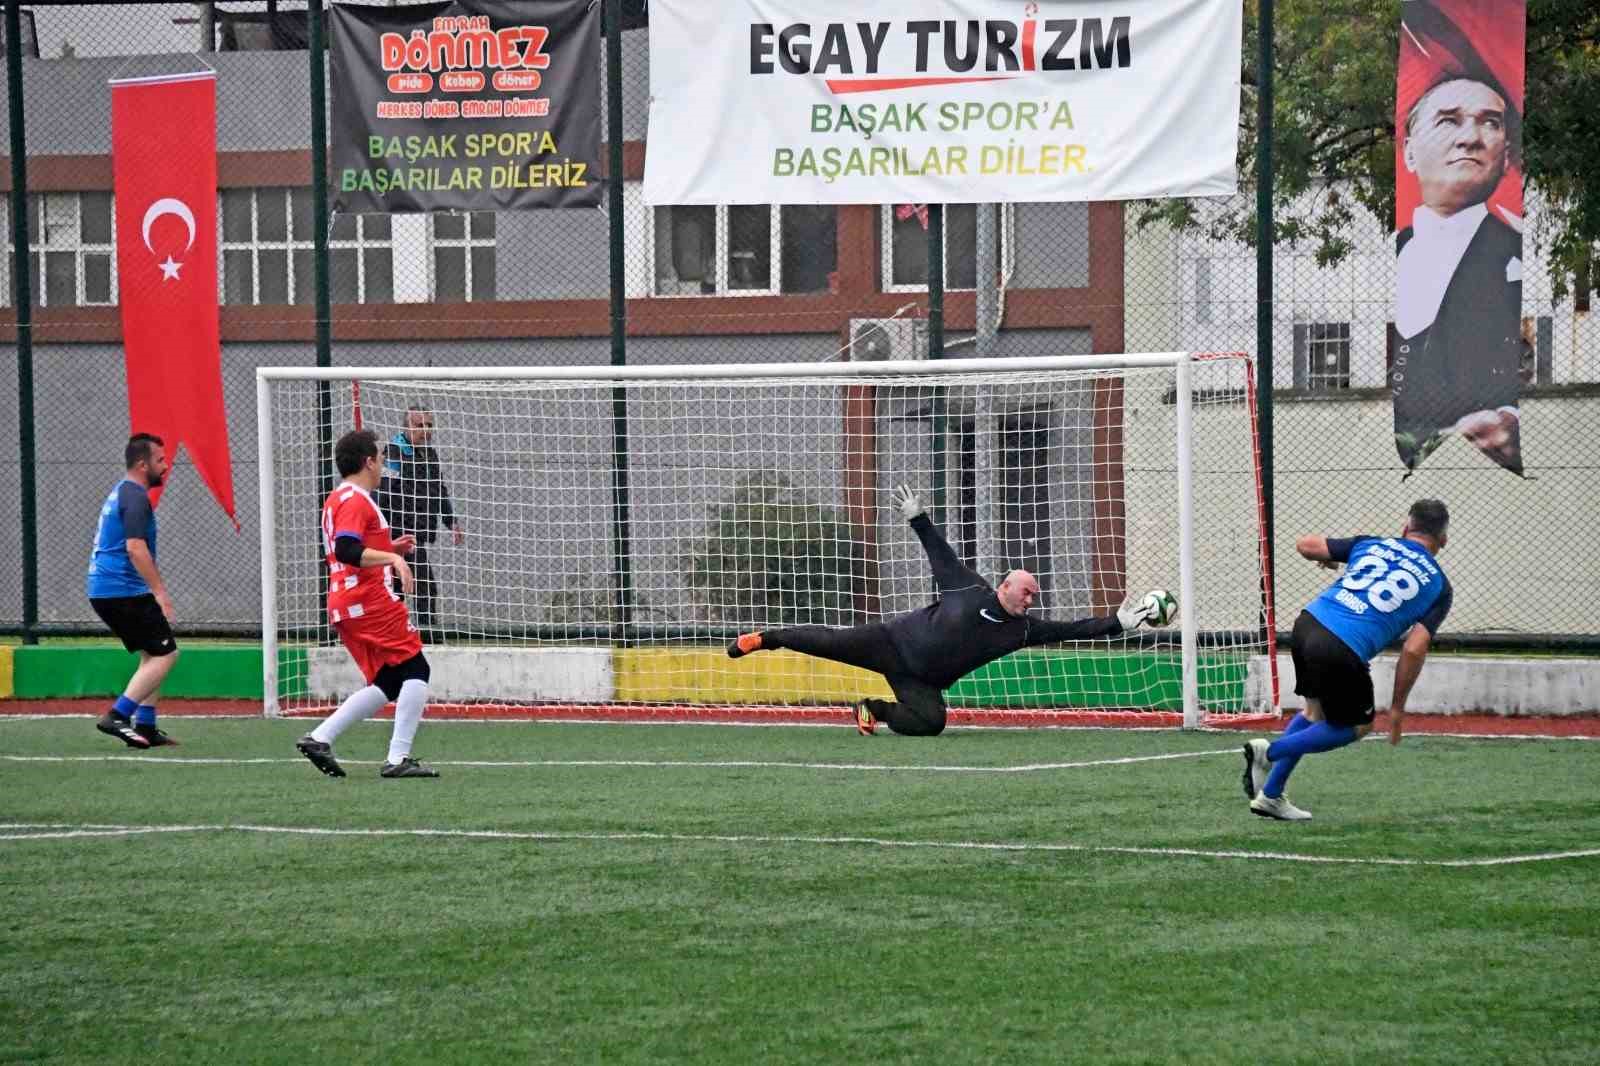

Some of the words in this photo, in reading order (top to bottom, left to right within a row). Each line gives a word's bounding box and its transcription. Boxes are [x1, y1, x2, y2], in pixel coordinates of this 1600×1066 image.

[433, 16, 490, 32] EMRAH
[750, 21, 891, 75] EGAY
[399, 77, 423, 90] pide
[498, 74, 534, 87] döner
[377, 101, 422, 118] HERKES
[424, 99, 459, 118] DÖNER
[461, 100, 502, 117] EMRAH
[810, 102, 927, 140] BAŞAK
[938, 100, 1074, 132] SPOR'A
[368, 135, 457, 163] BAŞAK
[464, 131, 558, 157] SPOR'A
[341, 167, 482, 197] BAŞARILAR
[490, 159, 588, 189] DİLERİZ
[773, 146, 968, 184] BAŞARILAR
[1342, 555, 1419, 613] 08
